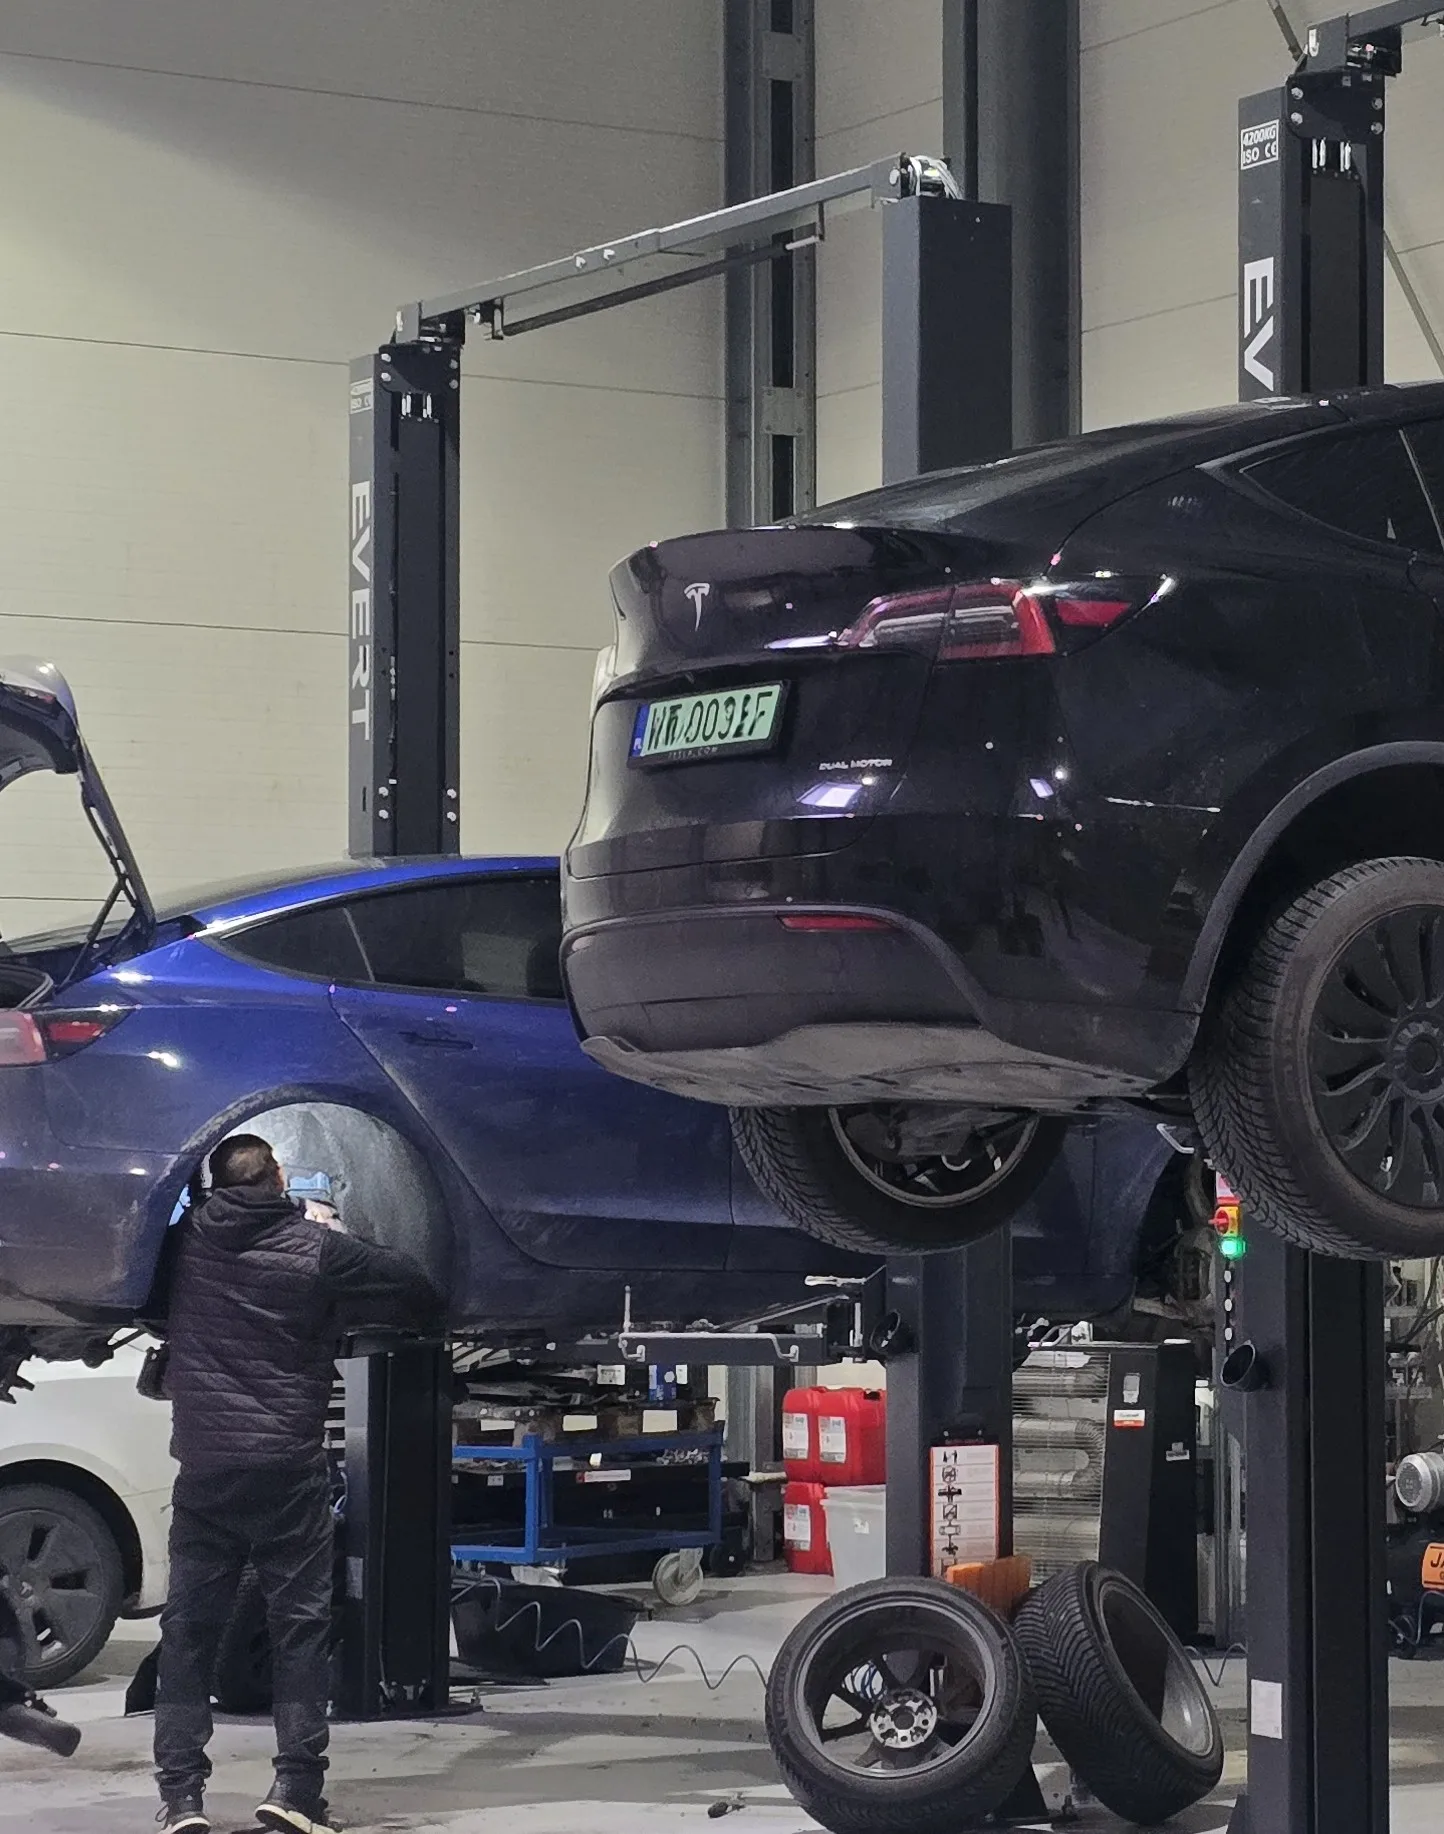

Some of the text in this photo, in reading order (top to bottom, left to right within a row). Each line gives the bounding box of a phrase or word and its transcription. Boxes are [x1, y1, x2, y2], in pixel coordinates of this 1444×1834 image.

[1243, 125, 1276, 146] 4200KG
[1243, 147, 1260, 164] ISO
[352, 481, 371, 740] EVERT
[819, 759, 893, 771] DUAL MOTOR
